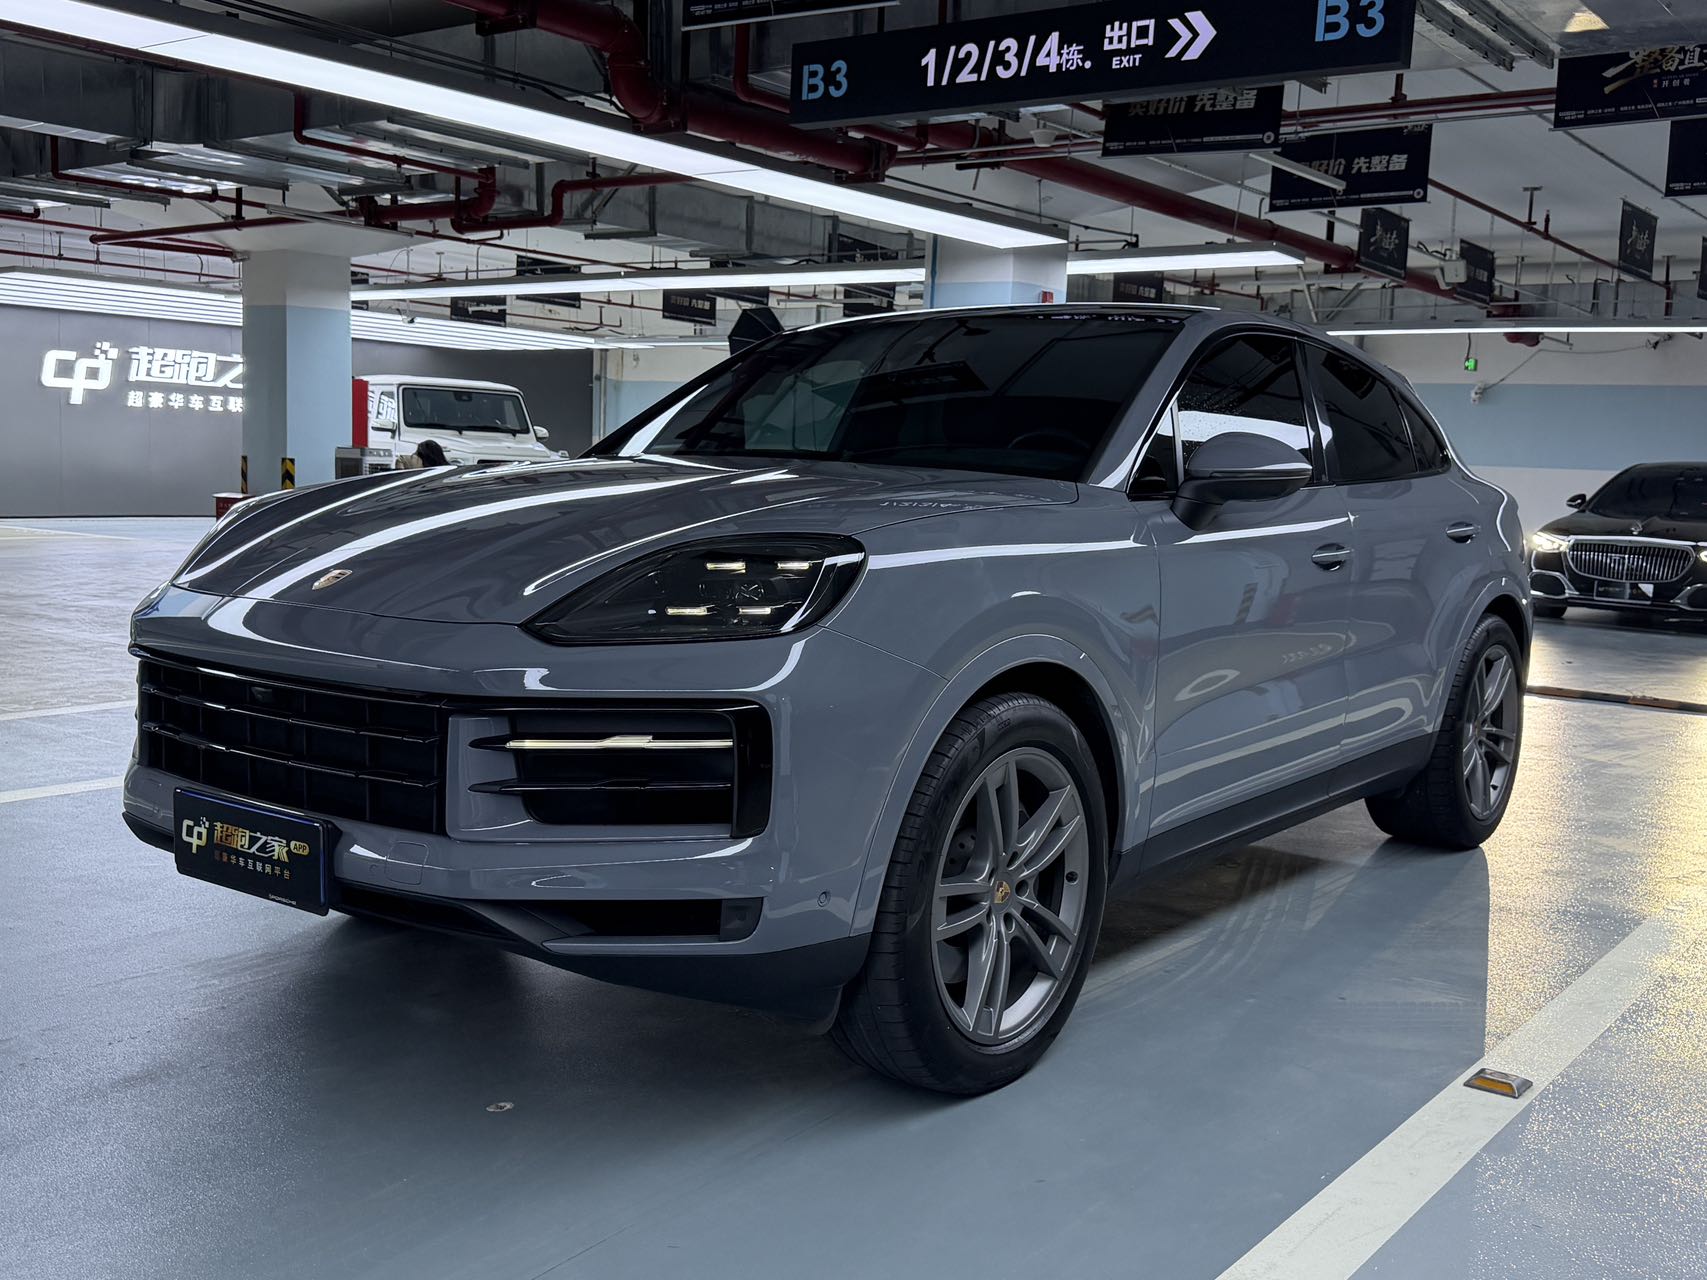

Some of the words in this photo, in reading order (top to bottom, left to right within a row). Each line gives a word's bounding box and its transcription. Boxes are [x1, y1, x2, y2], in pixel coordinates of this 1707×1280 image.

[1104, 18, 1156, 51] 出口
[1315, 0, 1385, 42] B3
[1112, 54, 1142, 69] EXIT
[802, 60, 848, 101] B3
[1301, 158, 1346, 176] 好价
[1351, 154, 1408, 174] 先整备
[213, 821, 290, 863] 超跑之家
[292, 842, 308, 854] APP
[214, 850, 292, 880] 华车互联网平台
